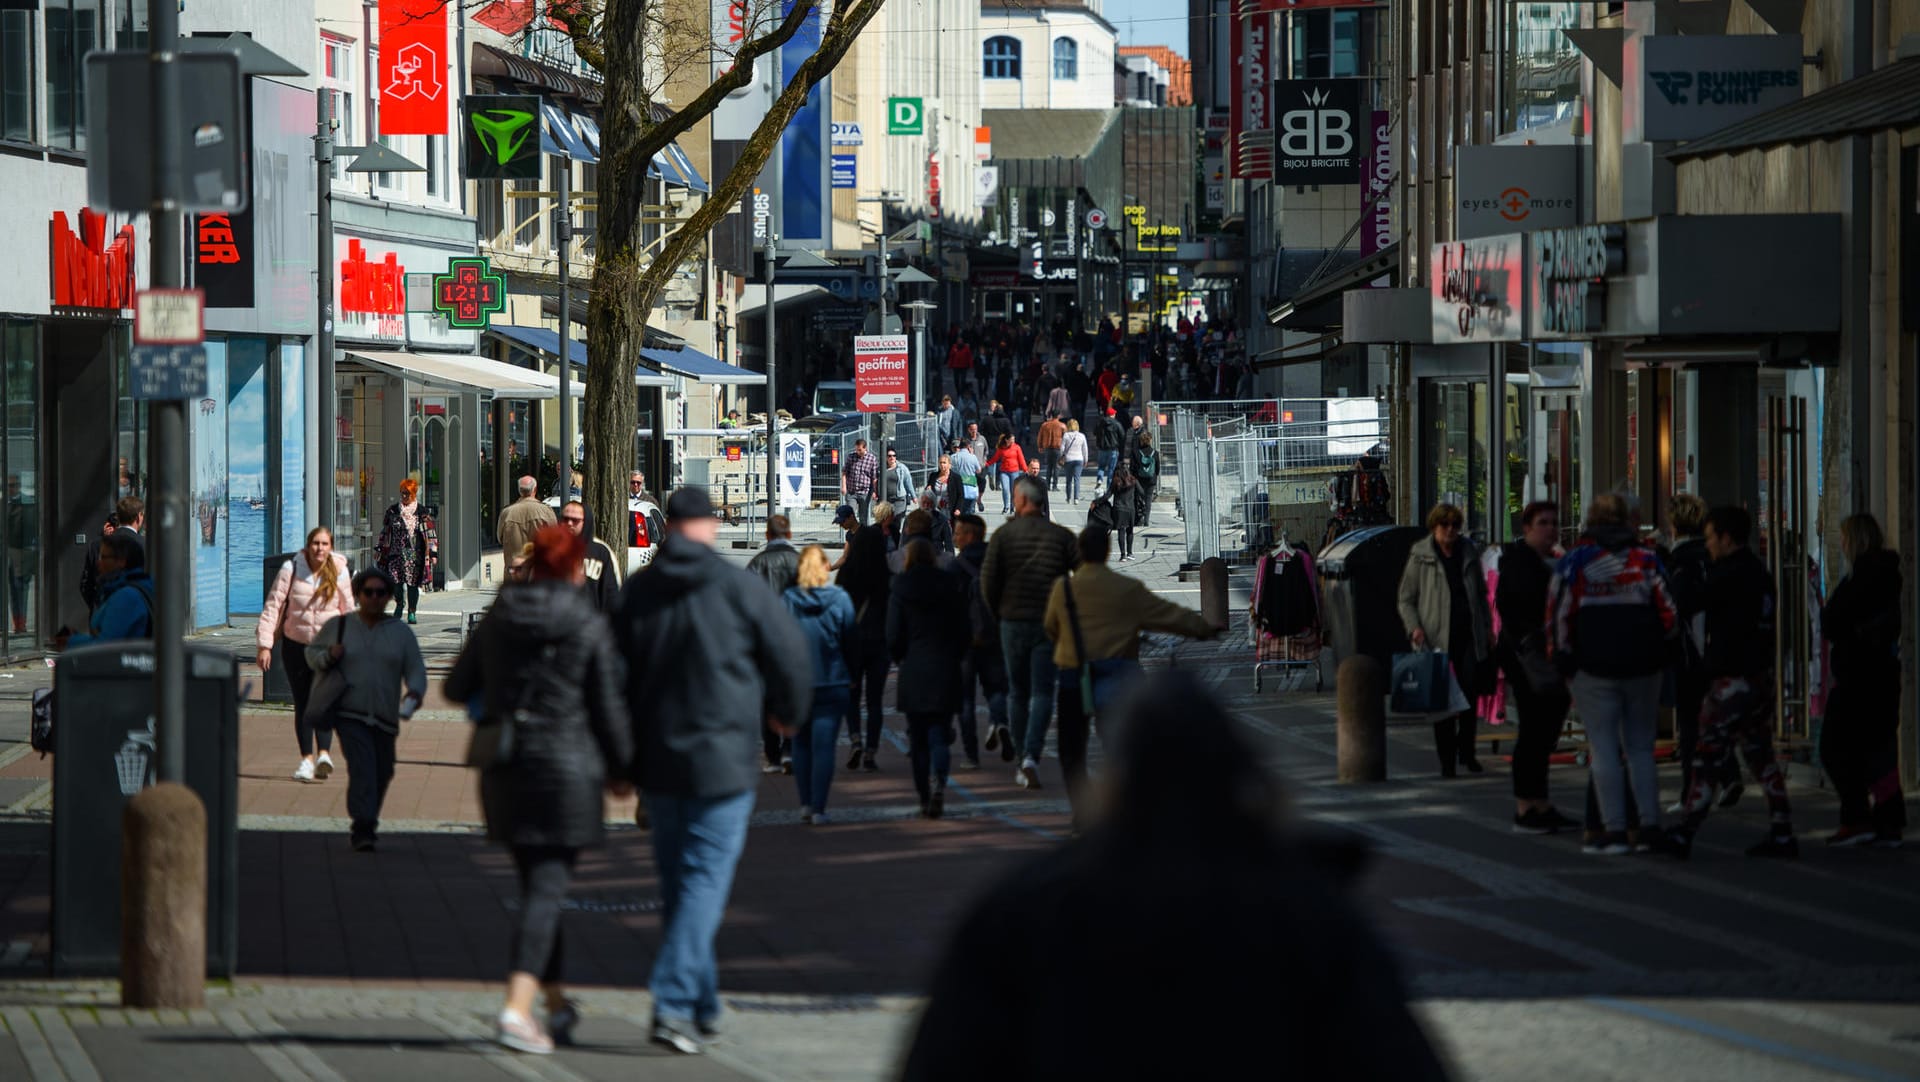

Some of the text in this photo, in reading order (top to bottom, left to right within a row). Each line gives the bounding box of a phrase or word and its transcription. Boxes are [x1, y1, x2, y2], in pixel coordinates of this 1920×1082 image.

[1697, 70, 1799, 88] RUNNERS
[1697, 87, 1763, 105] POINT
[894, 102, 918, 125] D
[1283, 158, 1350, 169] BIJOU BRIGITTE
[1124, 206, 1146, 216] pop
[1462, 198, 1574, 212] eyes more
[753, 192, 770, 239] snipes
[1131, 217, 1146, 226] up
[858, 357, 906, 374] geöffnet
